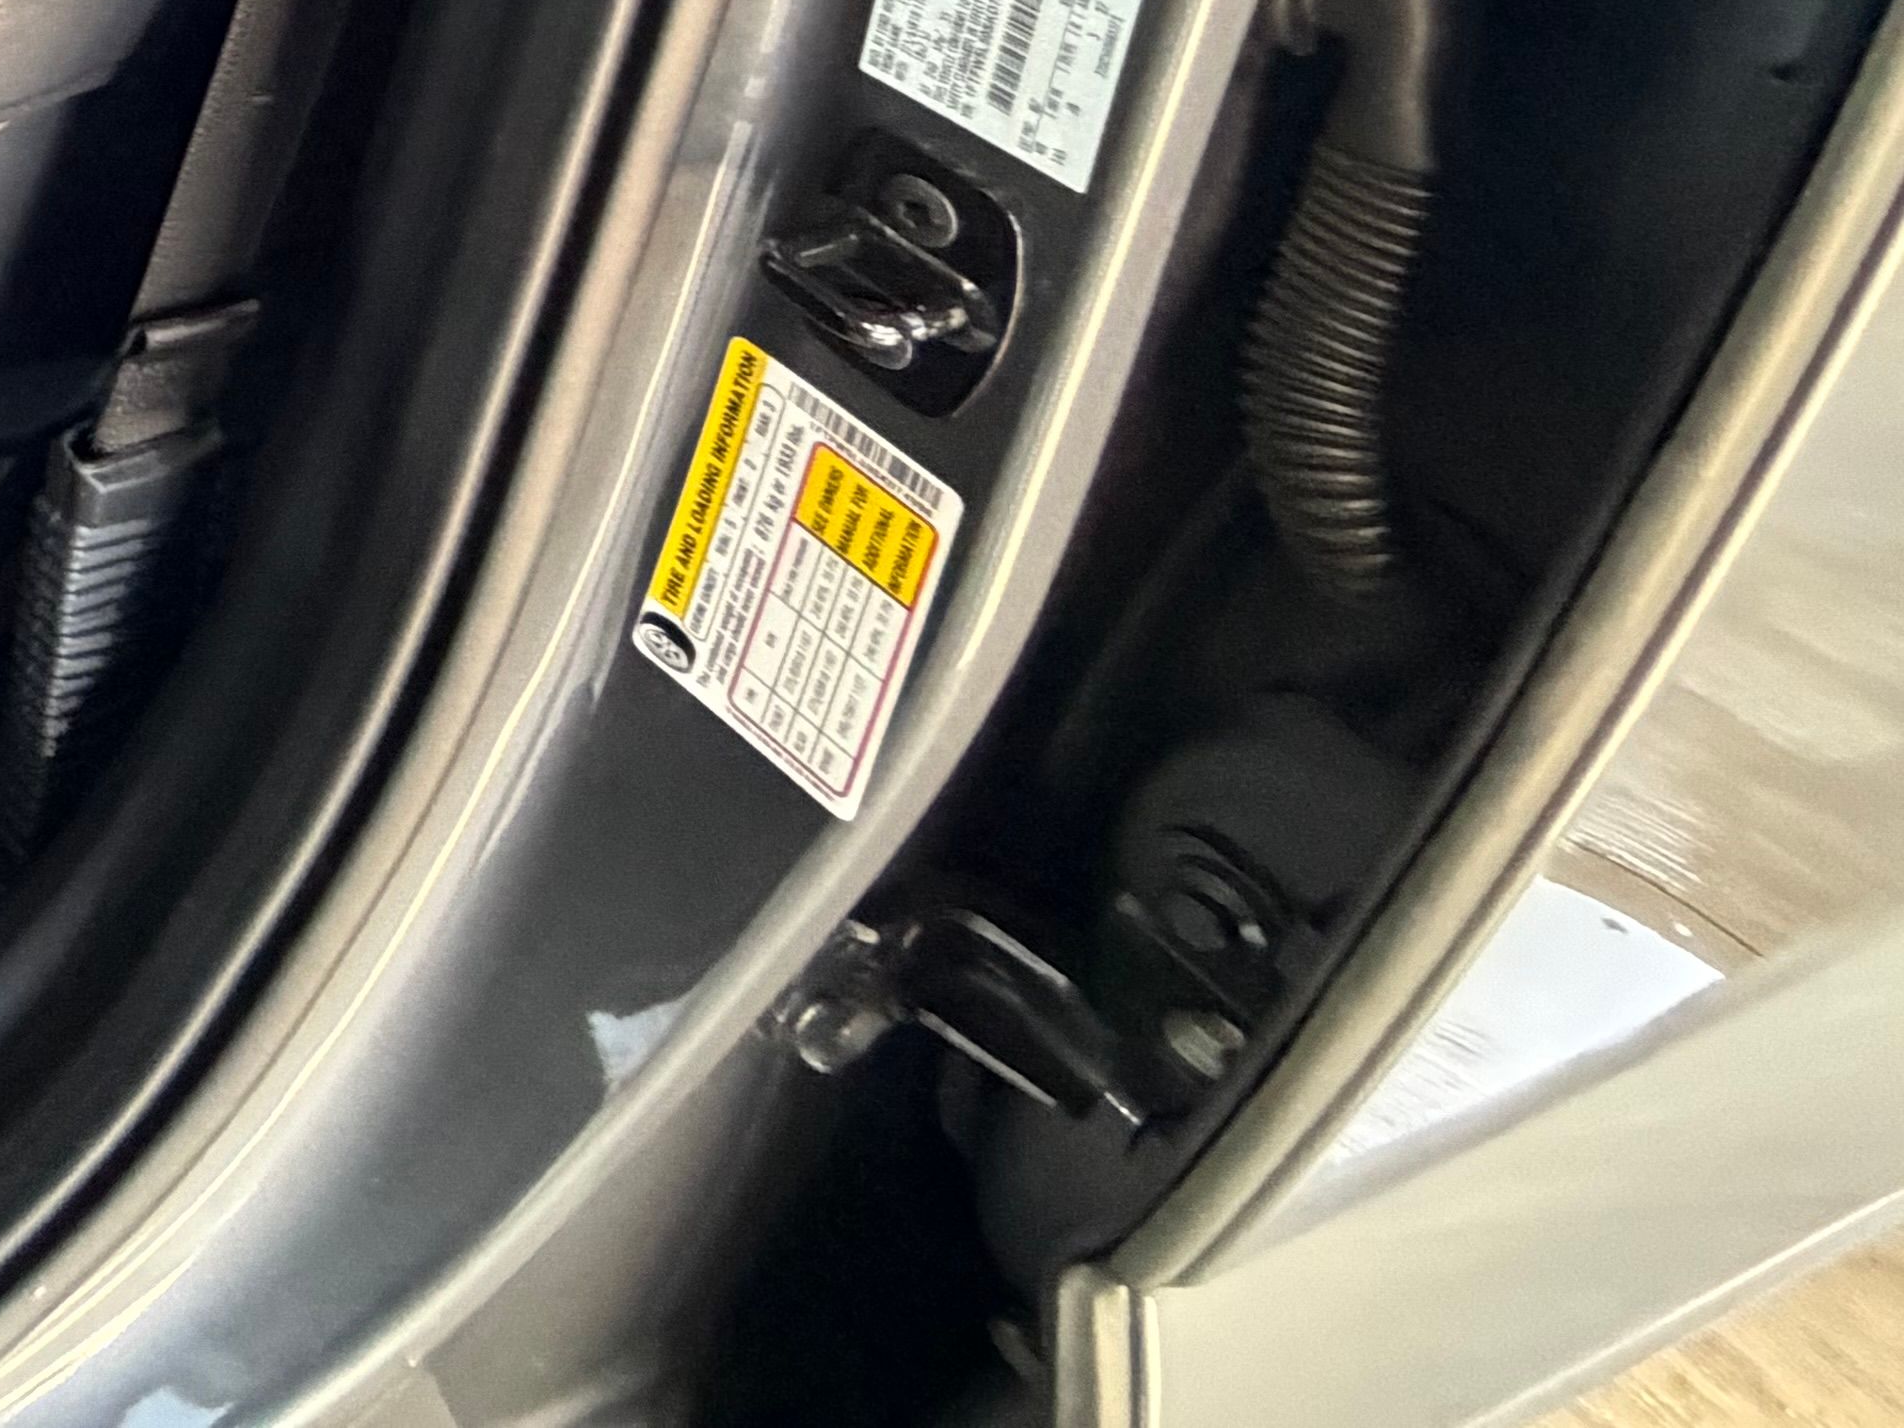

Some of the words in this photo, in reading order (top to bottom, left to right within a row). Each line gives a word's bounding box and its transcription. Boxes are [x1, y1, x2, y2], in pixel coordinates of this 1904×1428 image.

[706, 347, 760, 464] INFORMATION
[684, 459, 722, 536] LOADING
[762, 489, 785, 517] kg
[769, 475, 787, 496] or
[809, 509, 829, 537] SEE
[833, 504, 862, 556] MANUAL
[849, 481, 870, 511] FOR
[859, 502, 895, 573] ADDITIONAL
[672, 529, 697, 570] AND
[884, 516, 923, 596] INFORMATION
[658, 564, 686, 610] TIRE
